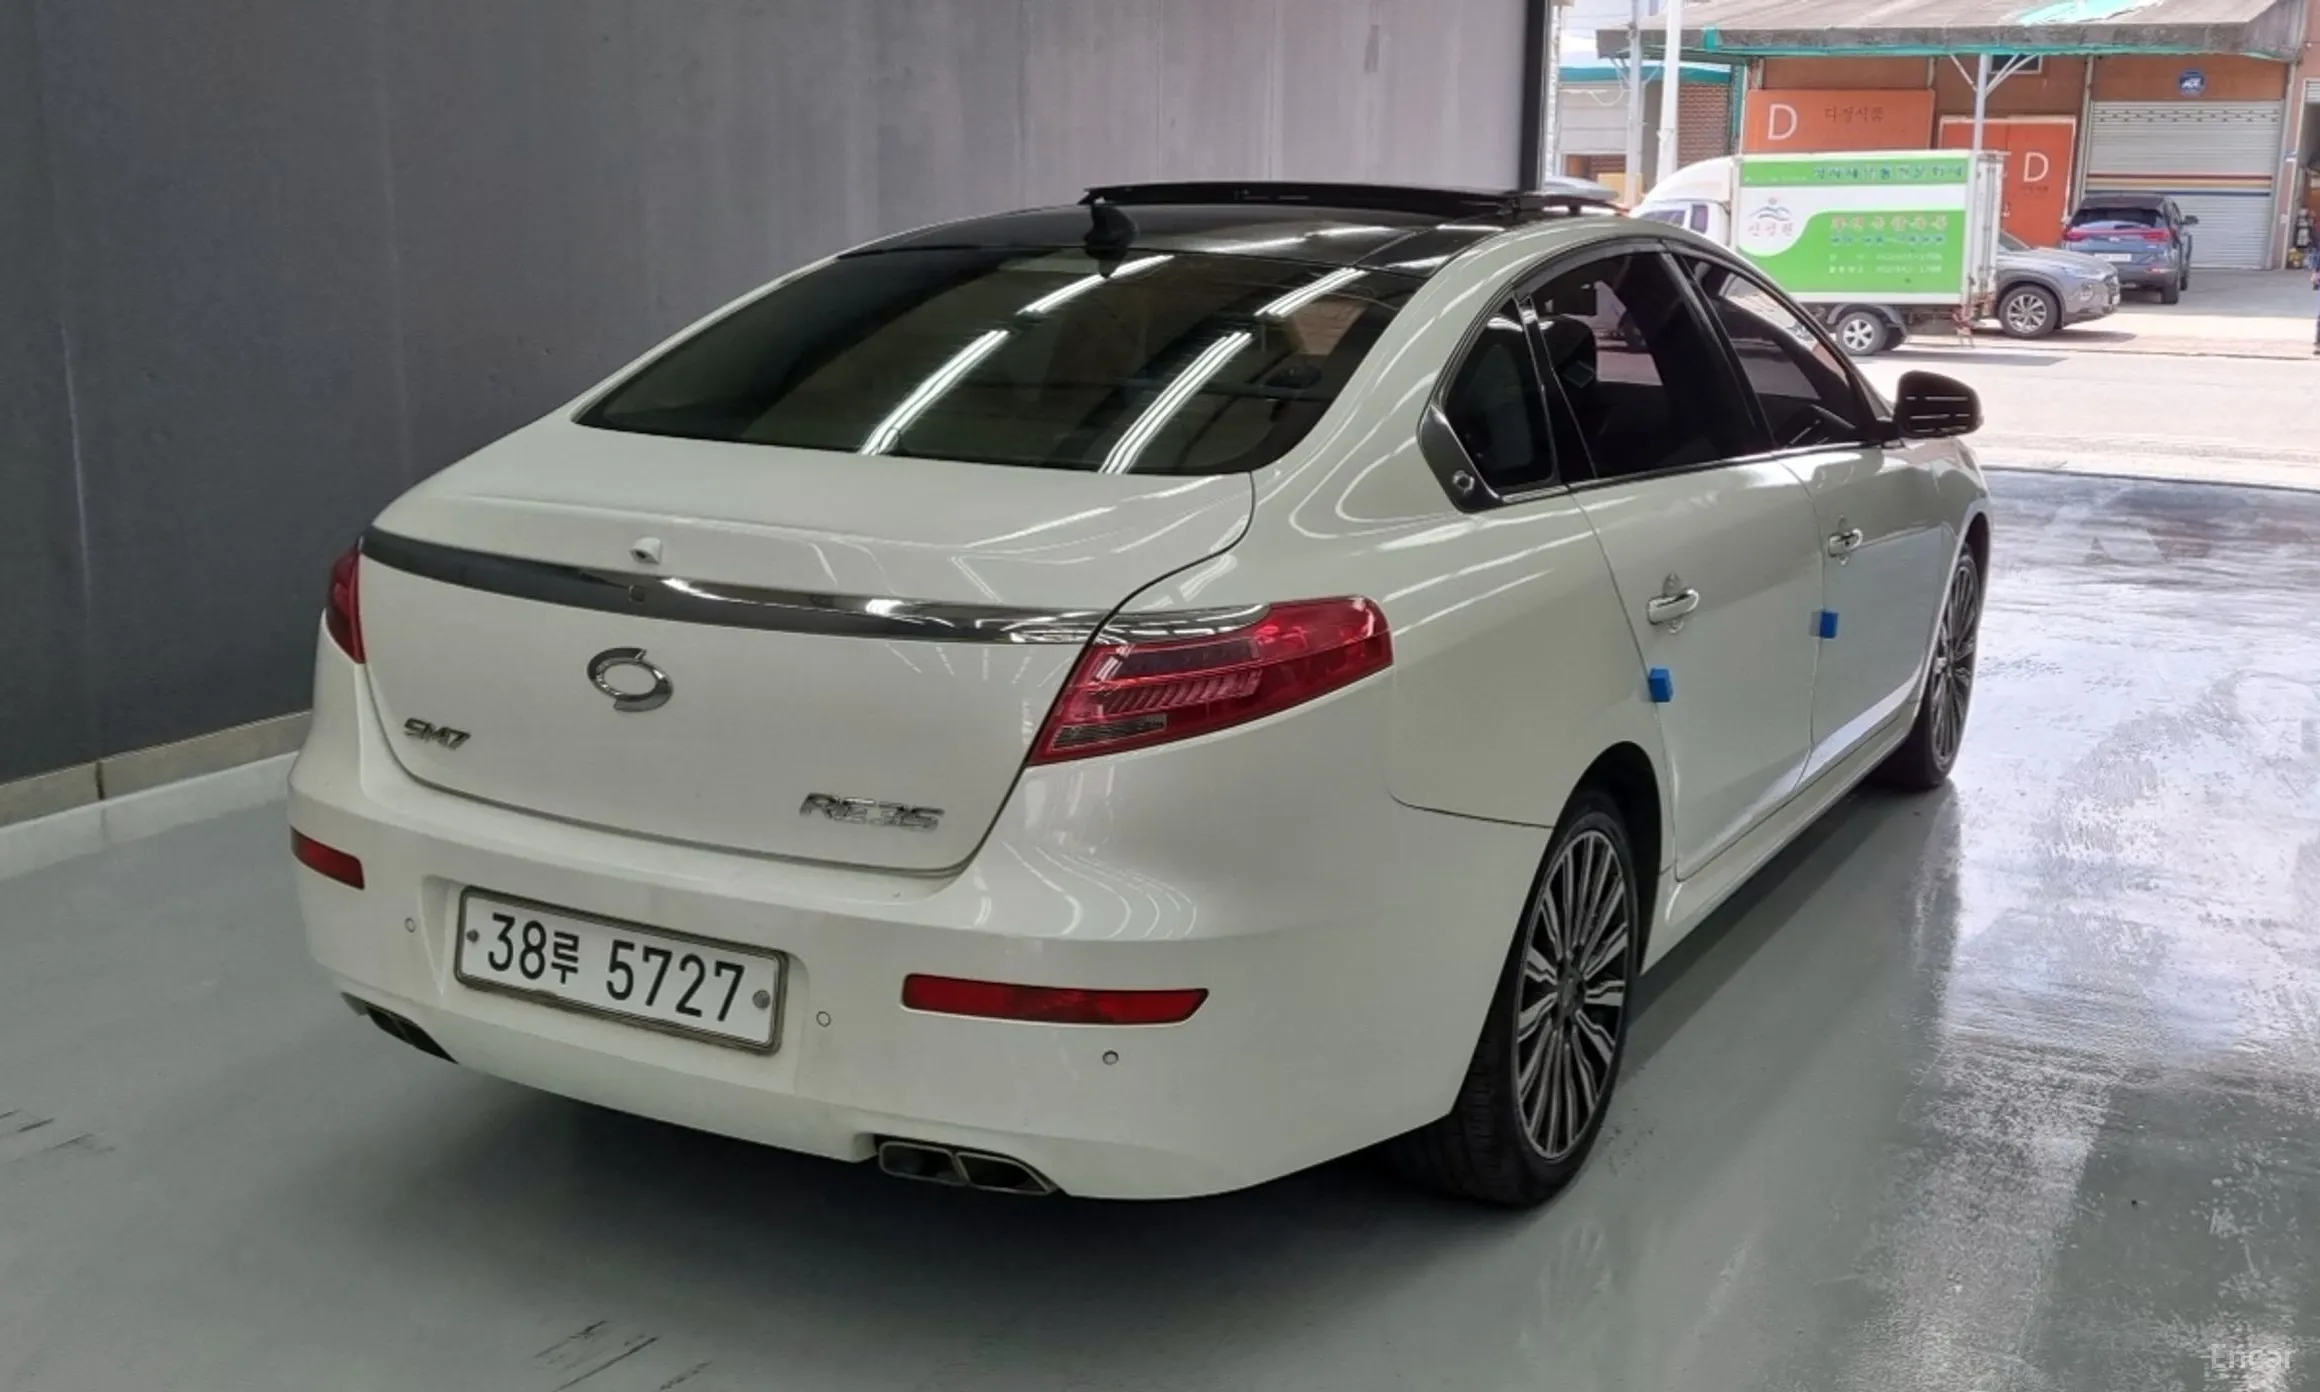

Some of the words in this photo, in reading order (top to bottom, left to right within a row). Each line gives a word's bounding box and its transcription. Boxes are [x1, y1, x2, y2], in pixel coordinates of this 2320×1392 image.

[1767, 103, 1798, 141] D
[2023, 152, 2049, 183] D
[404, 717, 471, 750] SM7
[488, 912, 580, 985] 38루
[606, 939, 745, 1022] 5727
